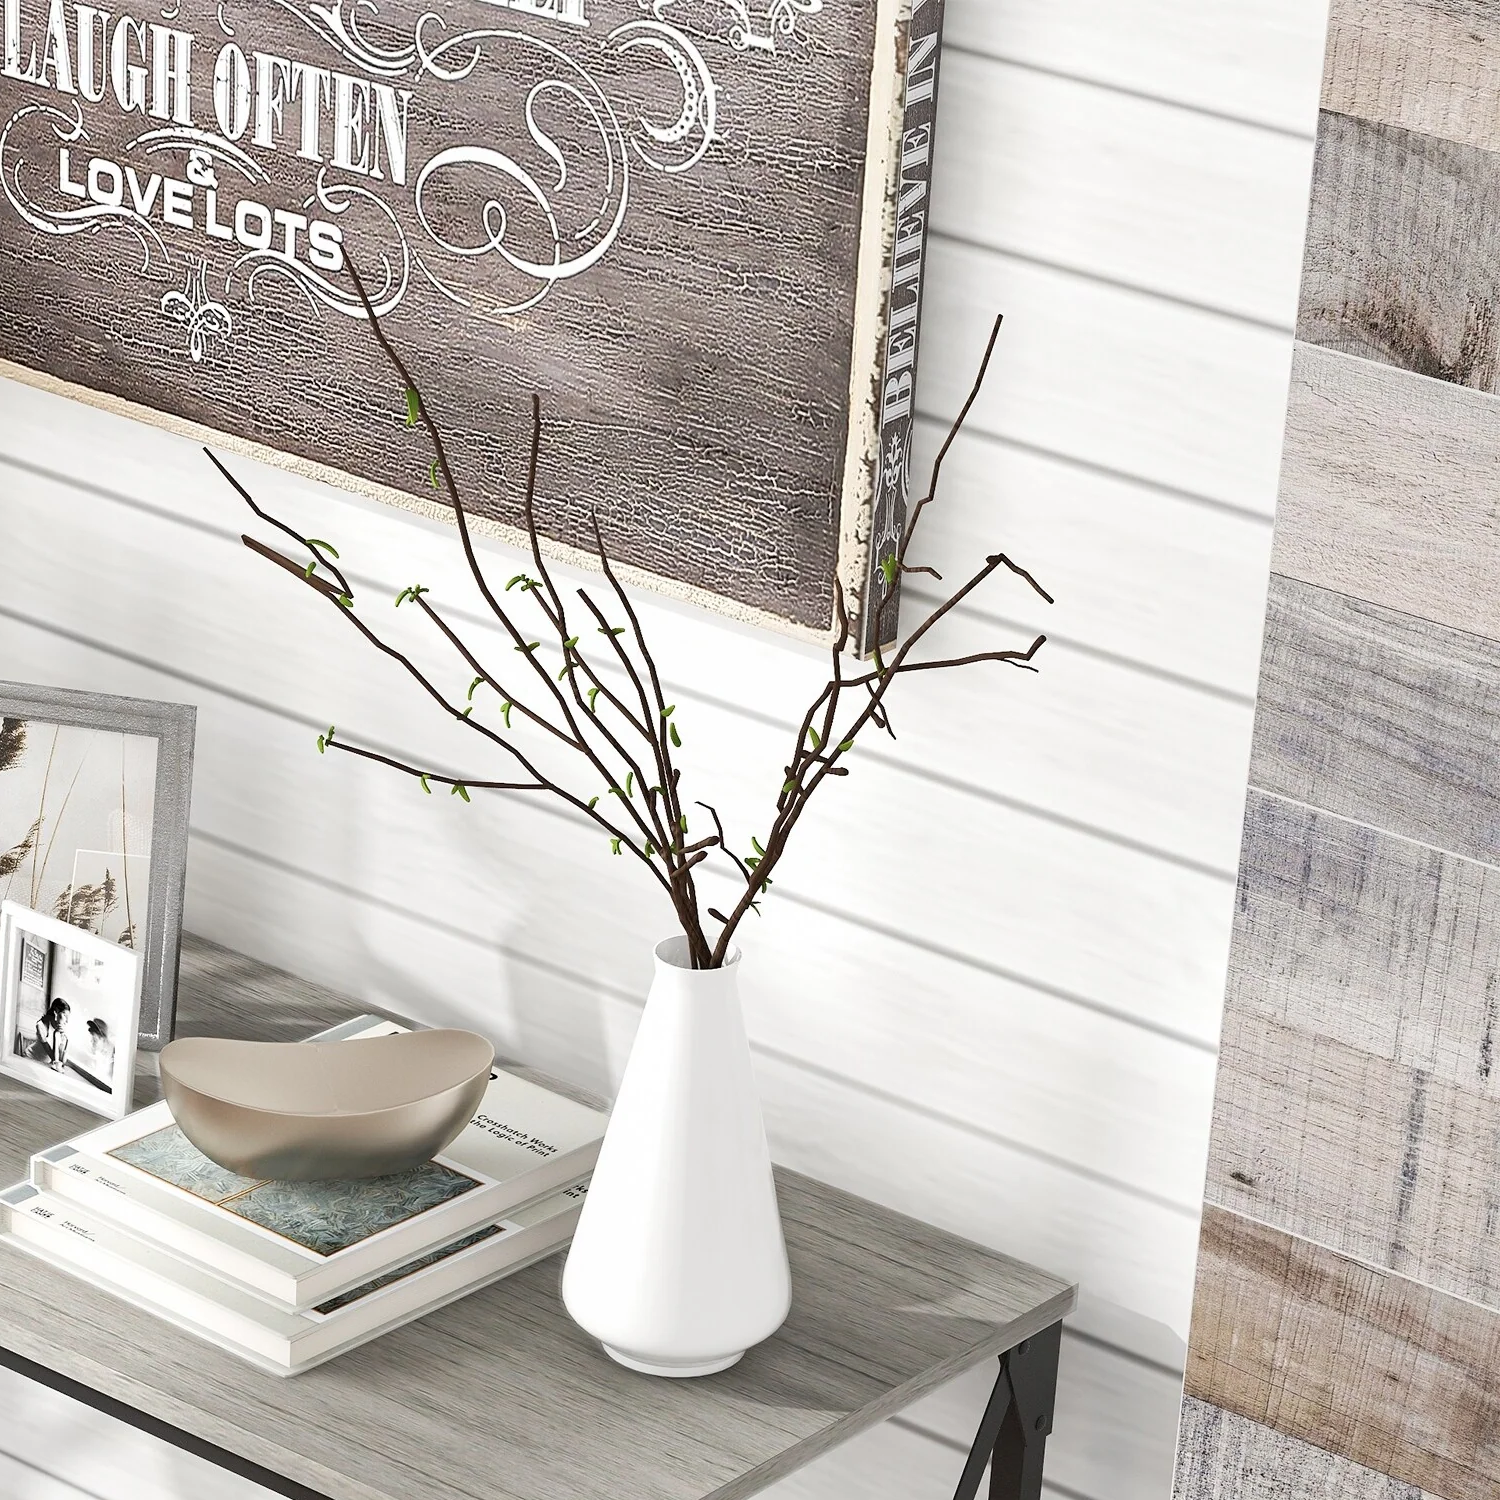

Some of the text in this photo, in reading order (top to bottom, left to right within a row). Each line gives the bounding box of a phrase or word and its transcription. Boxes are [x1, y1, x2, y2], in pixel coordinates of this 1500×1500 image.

[904, 32, 937, 112] IN
[0, 0, 413, 186] LAUGH OFTEN
[186, 150, 219, 190] &
[58, 148, 344, 271] LOVE LOTS
[882, 122, 932, 429] BELIEVE
[470, 1119, 550, 1158] the Logic of Print
[477, 1114, 559, 1153] Crosshatch Works
[562, 1188, 580, 1199] int
[571, 1184, 589, 1194] rks
